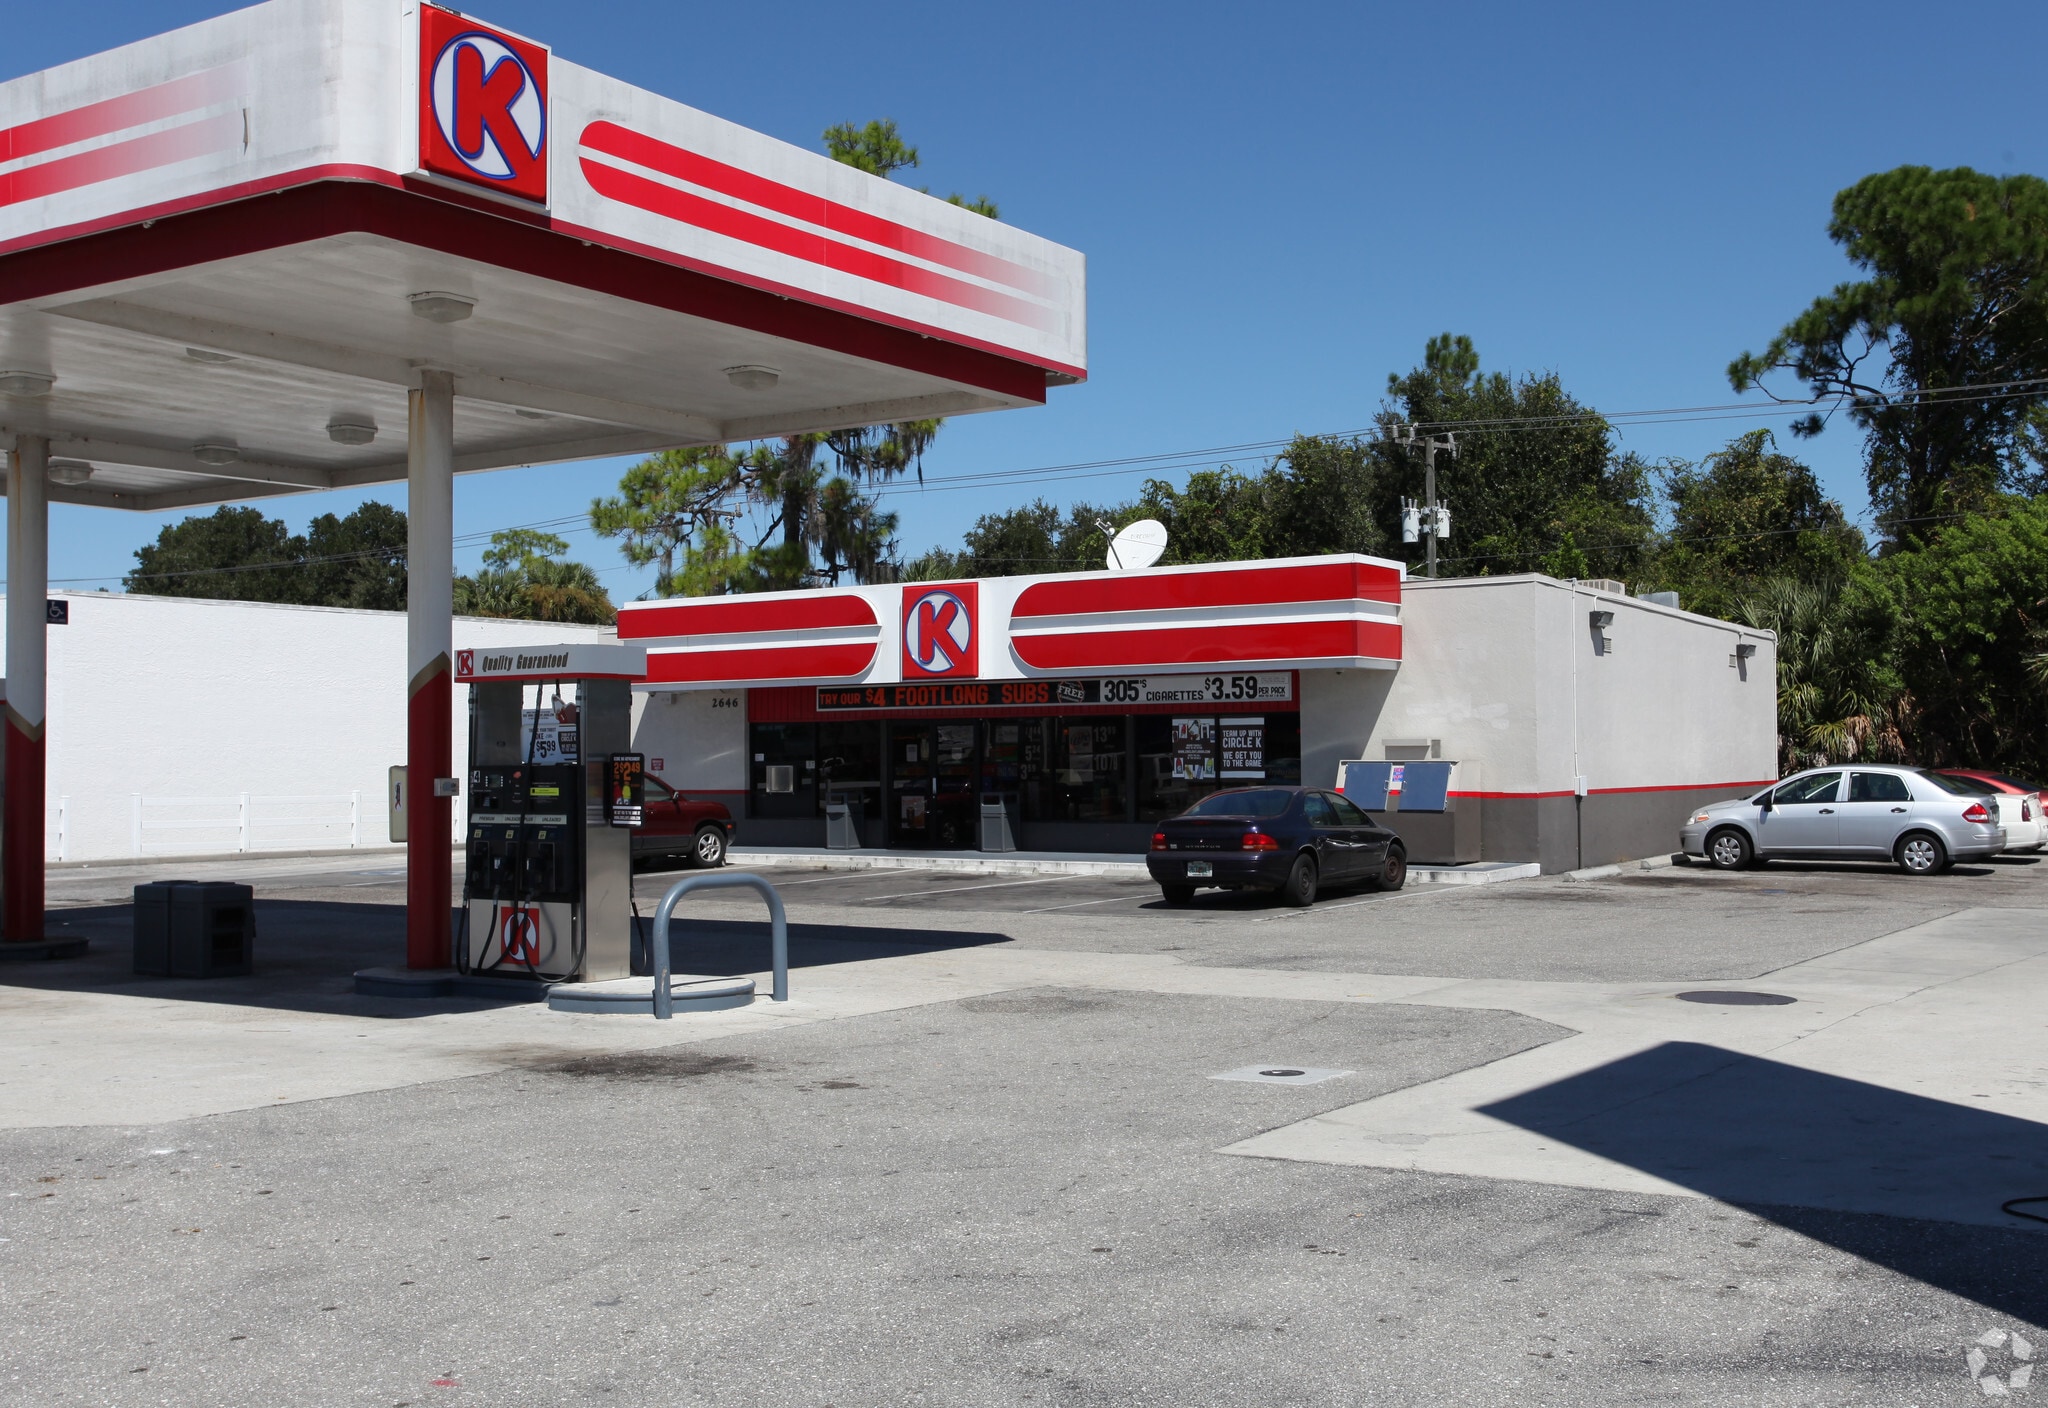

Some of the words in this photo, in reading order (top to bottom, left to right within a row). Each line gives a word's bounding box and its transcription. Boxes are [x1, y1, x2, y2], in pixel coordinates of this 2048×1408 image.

[452, 40, 537, 181] K
[917, 598, 966, 668] K
[459, 653, 473, 675] K
[482, 655, 513, 672] Quality
[819, 693, 838, 705] TRY
[840, 693, 861, 704] OUR
[865, 687, 886, 707] $4
[895, 684, 989, 706] FOOTLONG
[1001, 683, 1049, 704] SUBS
[1057, 684, 1086, 700] FREE
[1104, 679, 1147, 703] 305'S
[1146, 690, 1204, 702] CIGARETTES
[1204, 676, 1258, 700] $3.59
[1258, 687, 1269, 695] PER
[1270, 686, 1286, 695] PACK
[711, 697, 739, 708] 2646
[1222, 729, 1239, 737] TEAM
[1239, 729, 1247, 737] UP
[1248, 729, 1262, 737] WITH
[1222, 737, 1253, 748] CIRCLE
[1255, 737, 1262, 748] K
[1222, 751, 1233, 760] WE
[1234, 751, 1247, 759] GET
[1249, 751, 1262, 759] YOU
